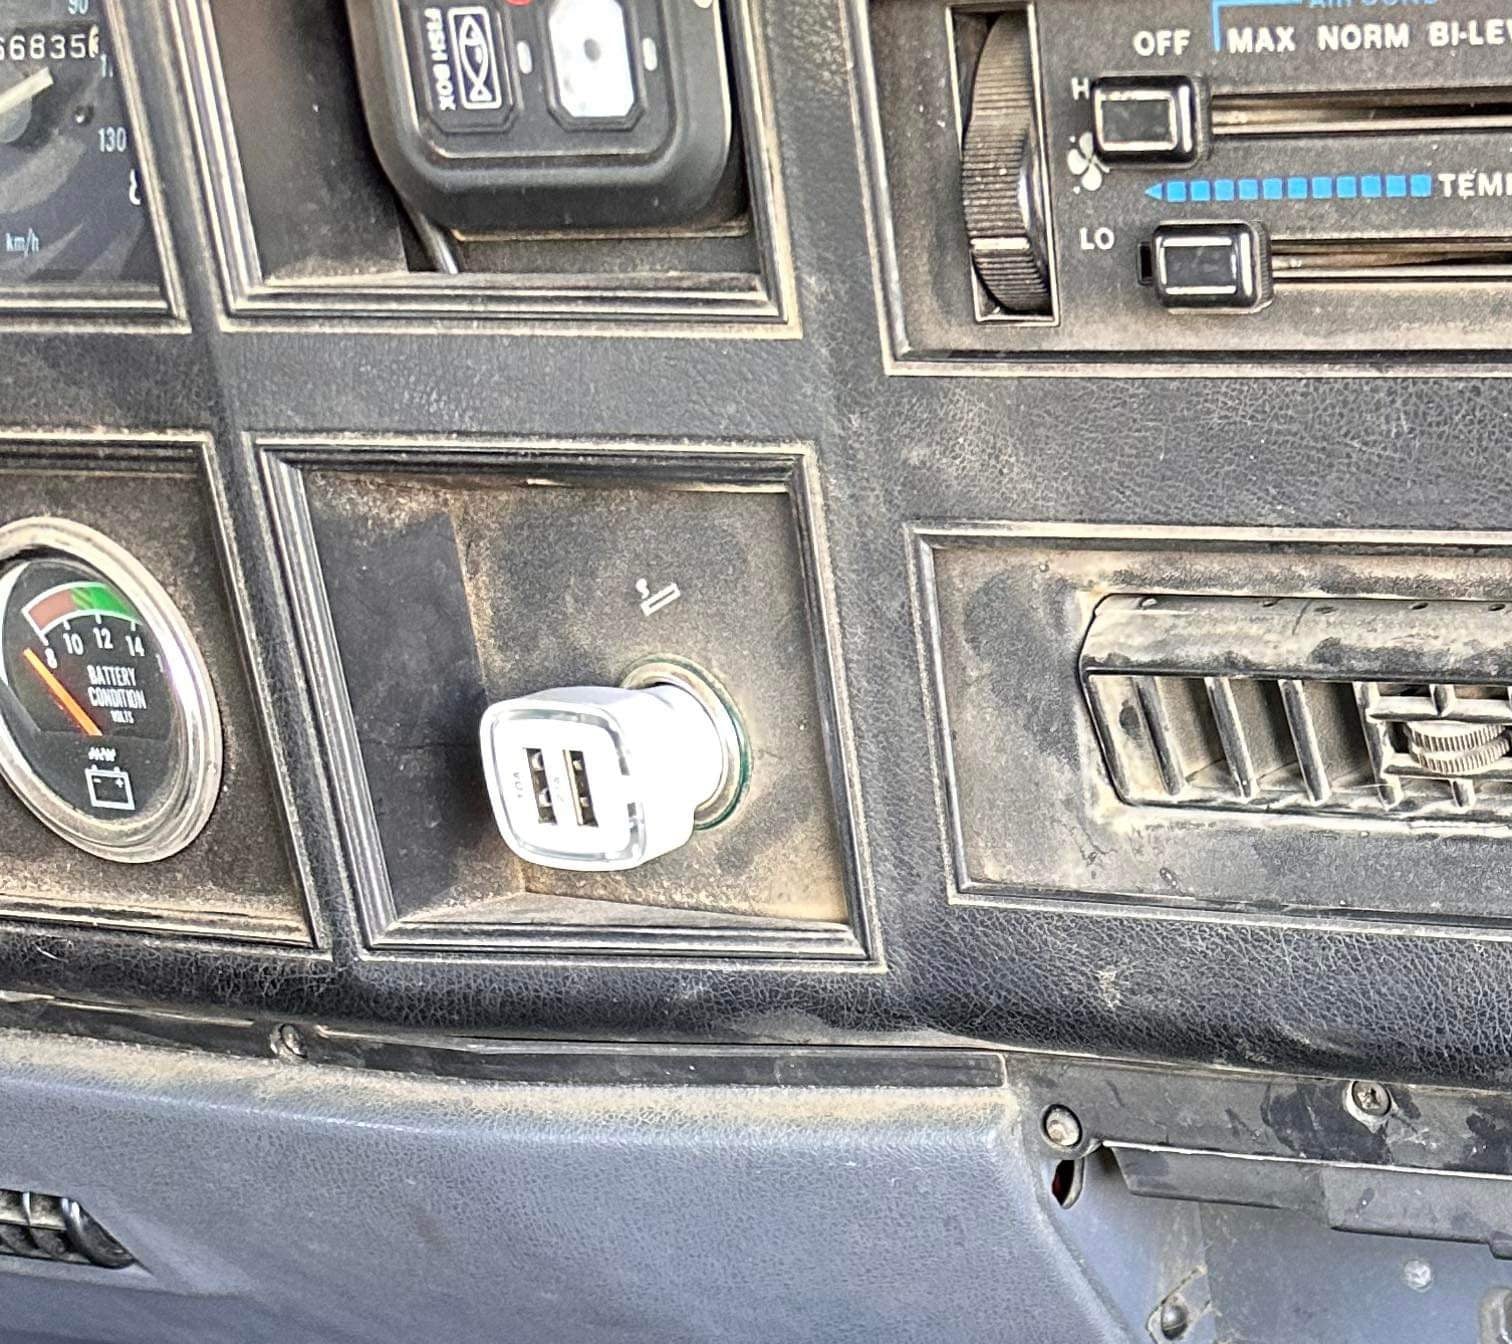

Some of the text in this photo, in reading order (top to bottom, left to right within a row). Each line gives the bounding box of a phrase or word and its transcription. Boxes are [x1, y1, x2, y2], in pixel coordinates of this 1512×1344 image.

[1133, 29, 1191, 56] OFF
[1227, 26, 1296, 53] MAX
[1317, 22, 1410, 50] NORM
[424, 7, 456, 111] FISH BOX
[98, 127, 127, 151] 130
[6, 228, 40, 258] km/h
[1080, 228, 1115, 251] LO
[44, 647, 58, 669] 8
[62, 632, 84, 656] 10
[92, 627, 114, 649] 12
[125, 635, 145, 657] 14
[87, 664, 137, 687] BATTERY
[88, 686, 148, 710] CONDITION
[110, 710, 135, 724] VOLTS
